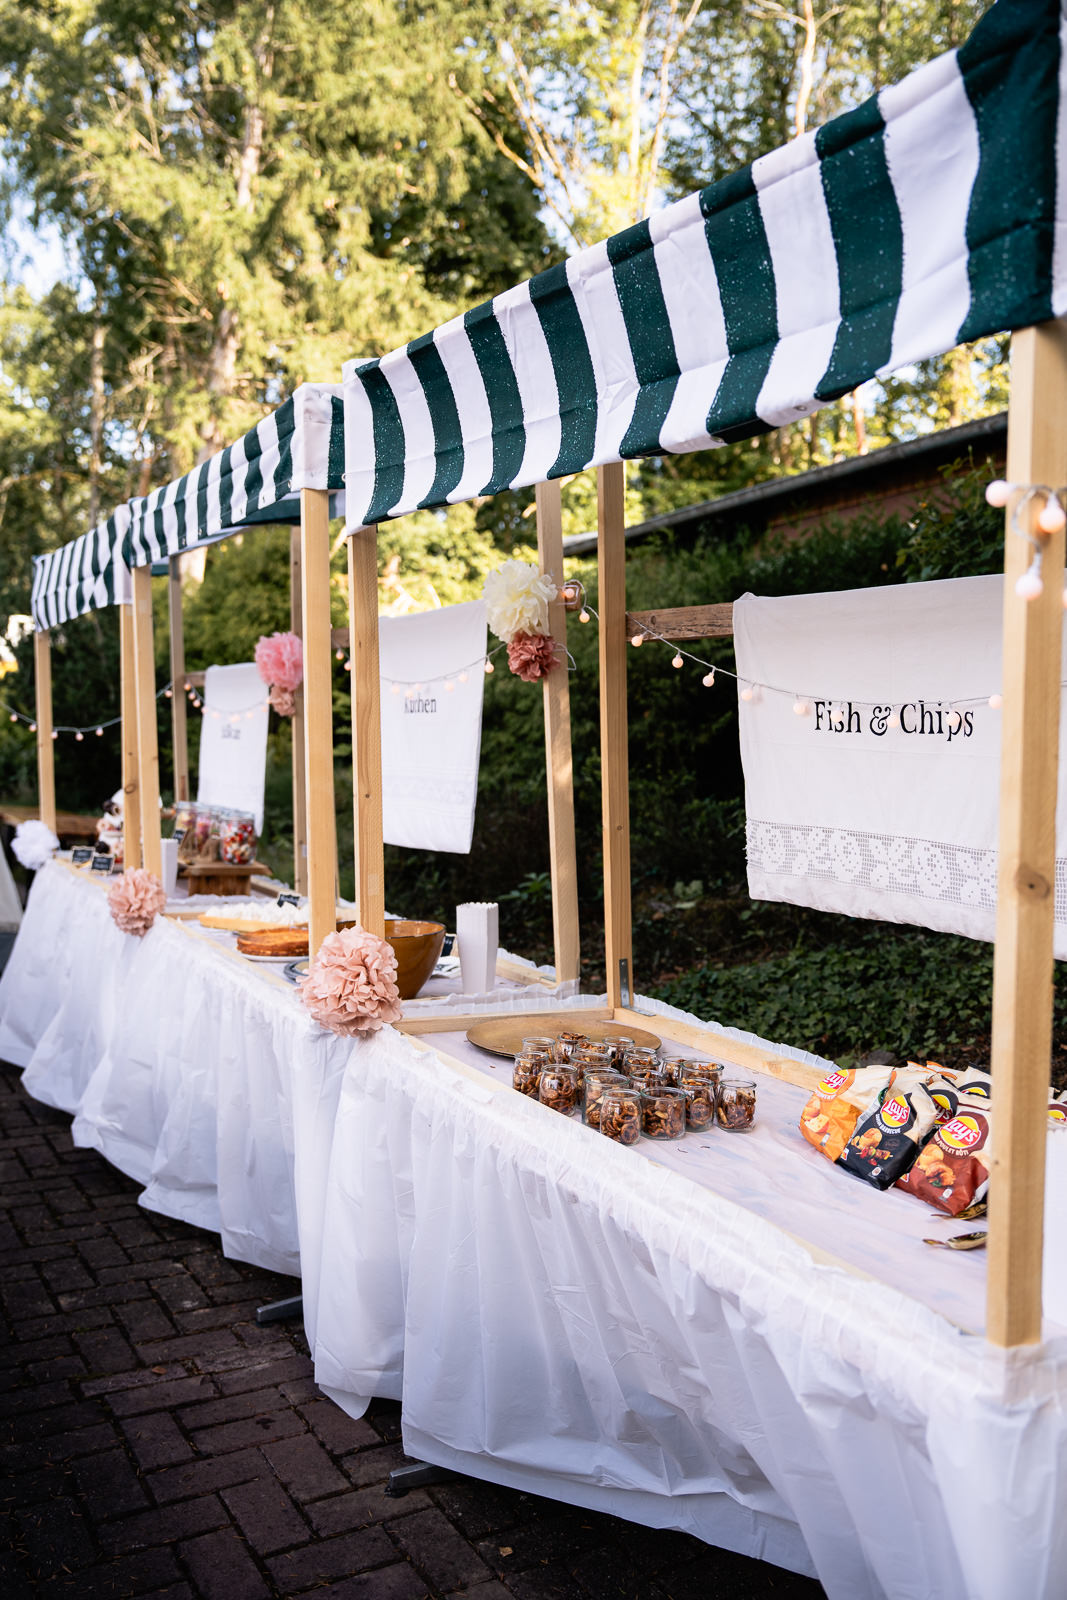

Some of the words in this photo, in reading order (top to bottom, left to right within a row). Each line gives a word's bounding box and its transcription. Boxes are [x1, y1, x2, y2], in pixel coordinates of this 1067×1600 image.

[814, 701, 862, 733] Fish
[869, 705, 892, 736] &
[899, 700, 974, 742] Chips
[882, 1098, 908, 1121] Lay's
[942, 1118, 978, 1142] Lay's
